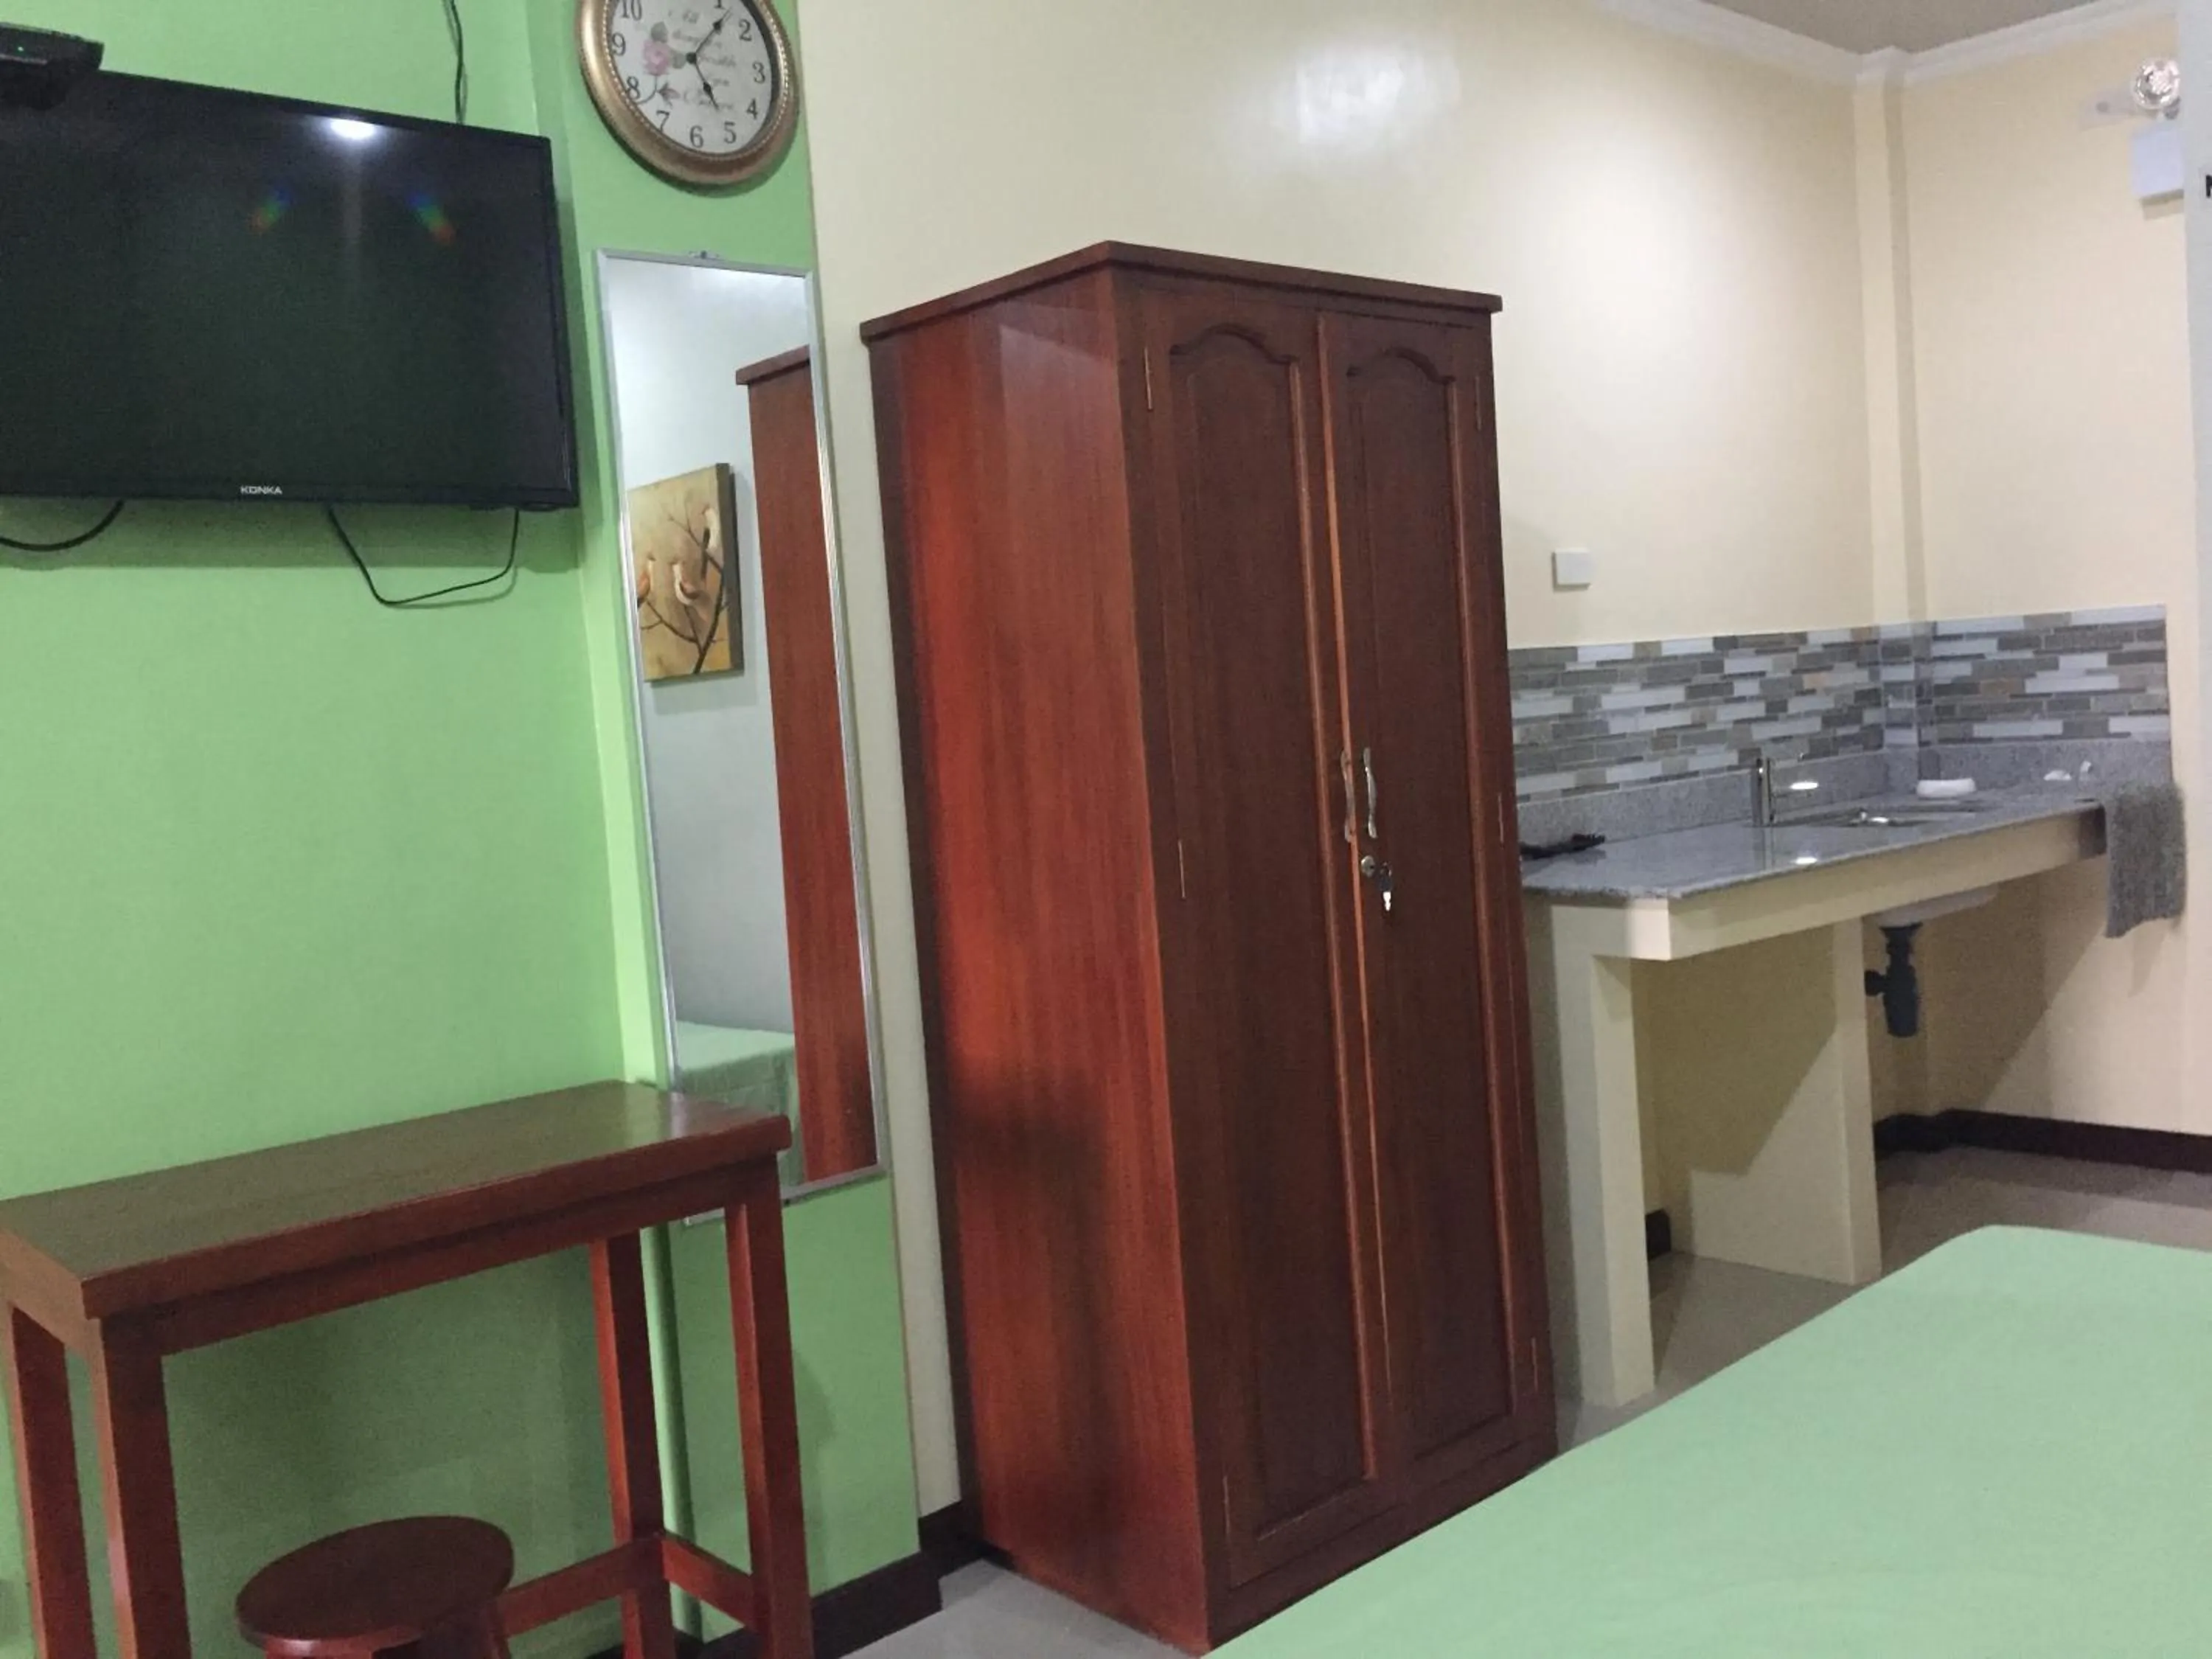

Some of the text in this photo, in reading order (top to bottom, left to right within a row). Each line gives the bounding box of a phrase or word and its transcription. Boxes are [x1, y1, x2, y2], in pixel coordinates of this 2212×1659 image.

[620, 0, 642, 21] 10
[739, 19, 752, 41] 2
[611, 32, 625, 56] 9
[753, 62, 765, 83] 3
[627, 76, 640, 100] 8
[746, 99, 757, 119] 4
[656, 111, 669, 133] 7
[723, 122, 737, 144] 5
[689, 125, 704, 147] 6
[240, 486, 282, 495] KONKA
